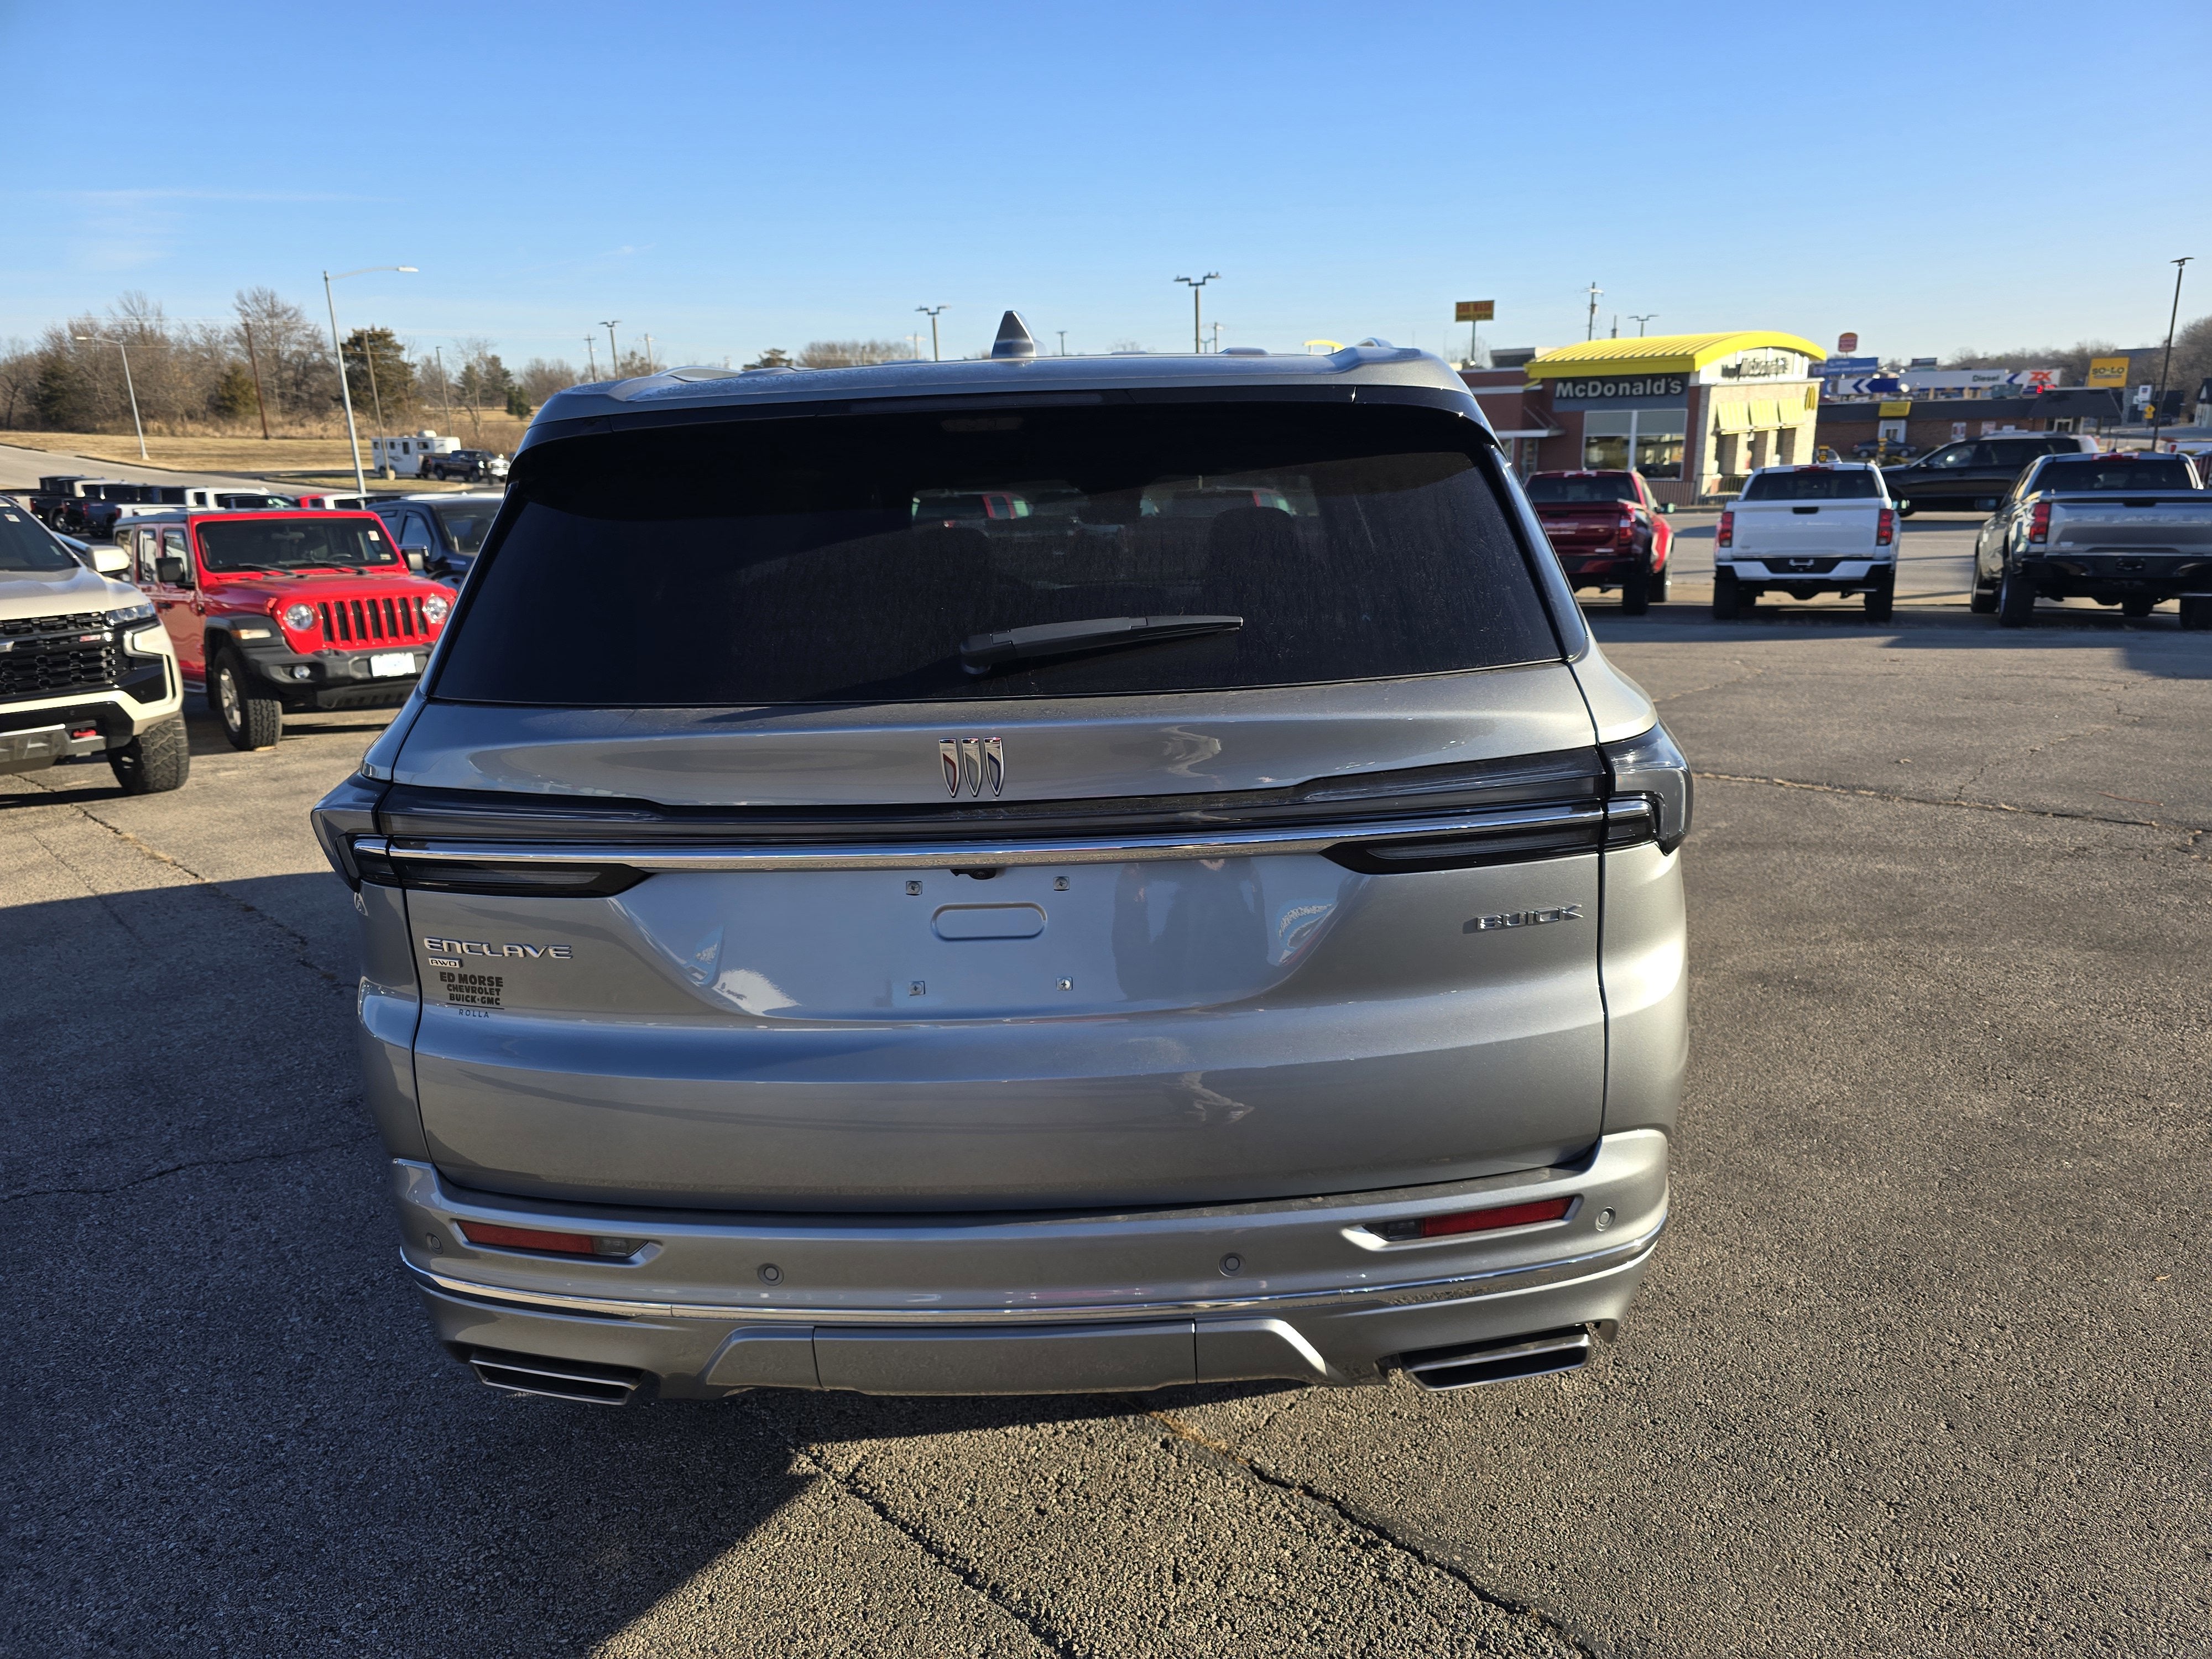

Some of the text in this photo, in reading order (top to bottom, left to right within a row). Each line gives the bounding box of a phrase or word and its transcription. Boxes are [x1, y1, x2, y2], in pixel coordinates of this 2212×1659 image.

[1972, 374, 2000, 383] Diesel
[1555, 378, 1682, 398] McDonald's
[1477, 904, 1584, 930] BUICK
[424, 937, 573, 959] ENCLAVE
[431, 959, 457, 967] AWD
[440, 972, 504, 987] ED MORSE
[447, 984, 501, 996] CHEVROLET
[459, 1009, 489, 1018] ROLLA
